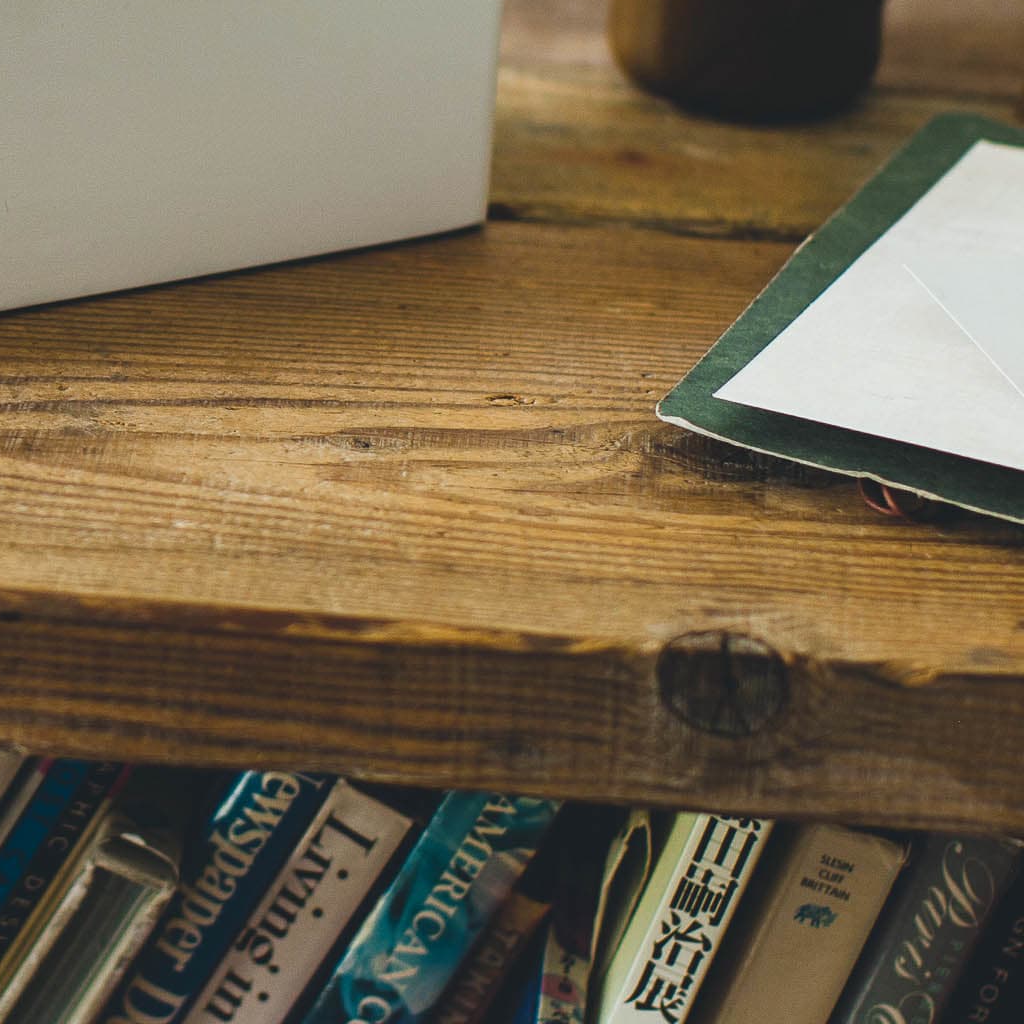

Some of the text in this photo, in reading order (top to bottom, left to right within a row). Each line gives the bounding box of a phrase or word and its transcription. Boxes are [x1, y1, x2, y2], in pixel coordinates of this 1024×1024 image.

[204, 811, 380, 1023] Living in
[376, 792, 518, 990] AMERICAN
[624, 813, 762, 1024] 田嗣治展
[799, 876, 851, 902] BRITTAIN
[894, 840, 995, 983] Paris
